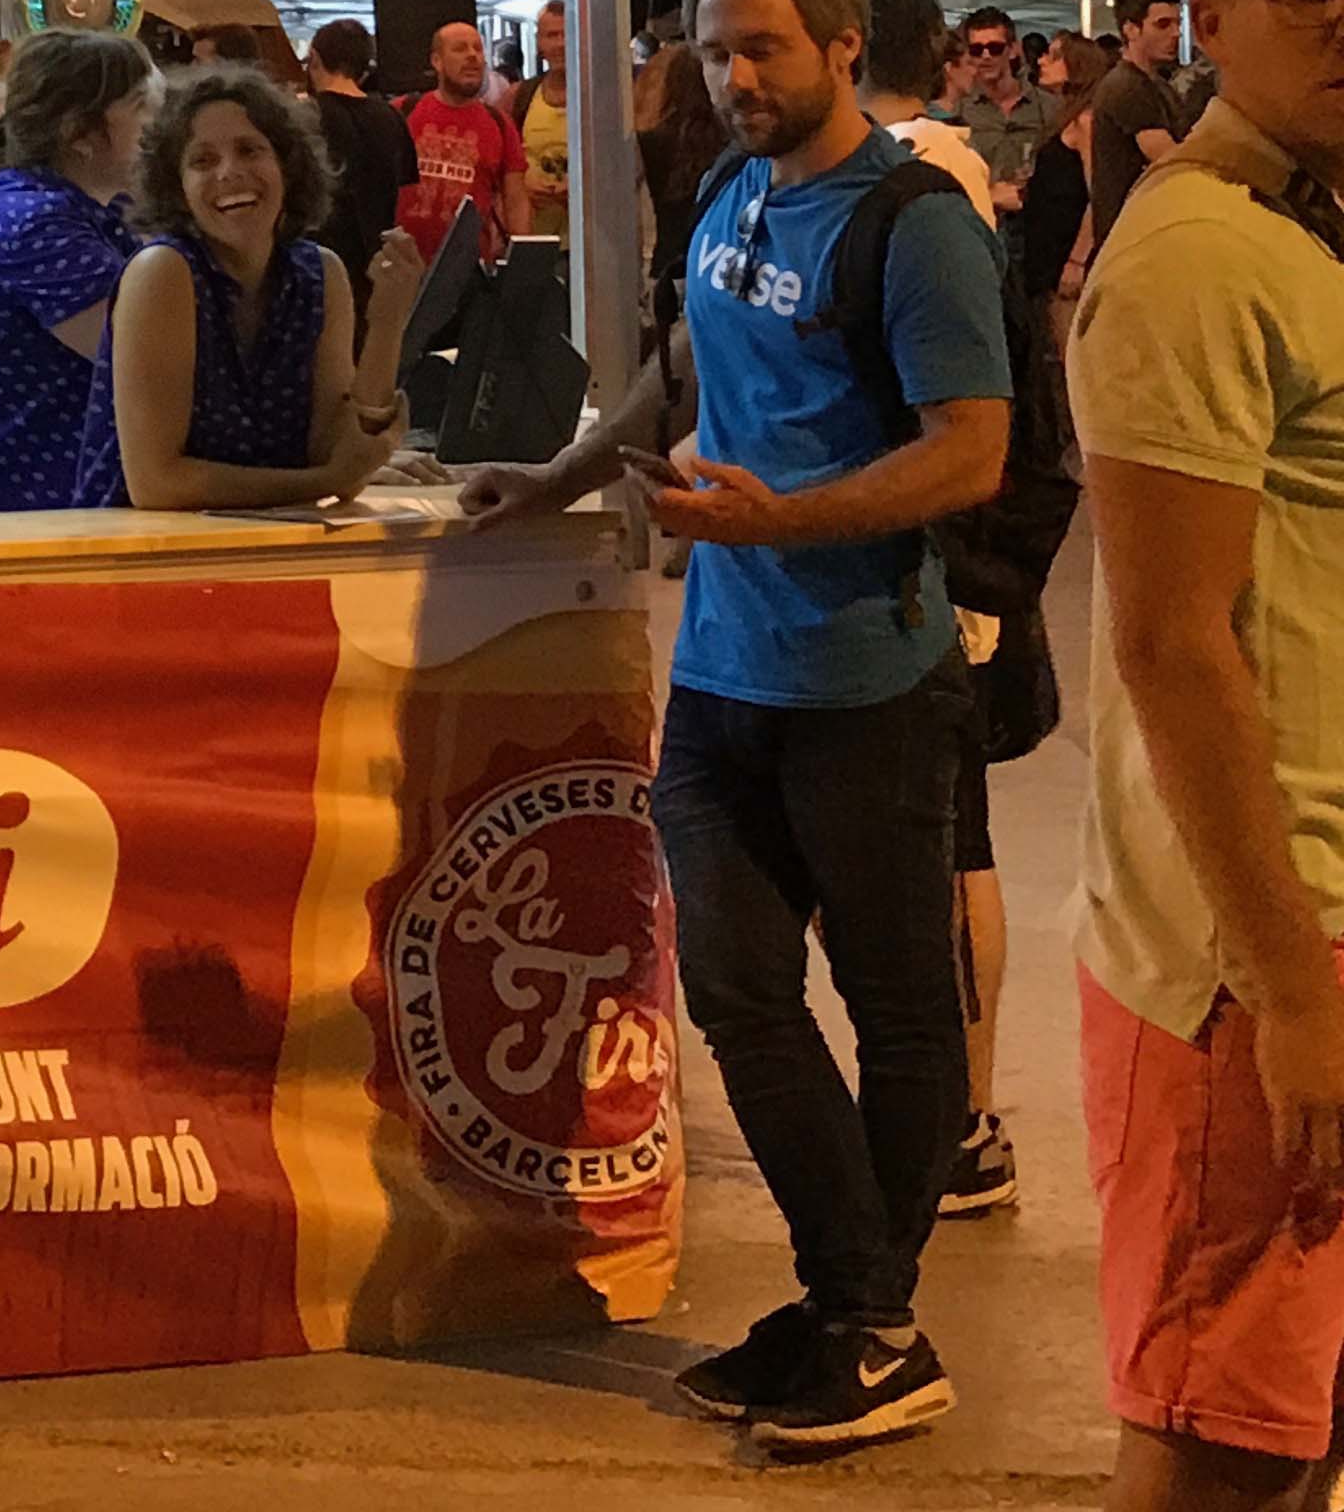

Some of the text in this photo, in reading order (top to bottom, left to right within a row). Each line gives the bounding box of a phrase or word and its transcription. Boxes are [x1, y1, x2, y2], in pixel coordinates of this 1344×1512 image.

[698, 234, 802, 317] vese
[429, 778, 615, 902] CERVESES
[401, 913, 436, 977] DE
[407, 990, 452, 1096] FIRA
[486, 944, 675, 1097] Fir
[461, 1115, 668, 1188] BARCELON
